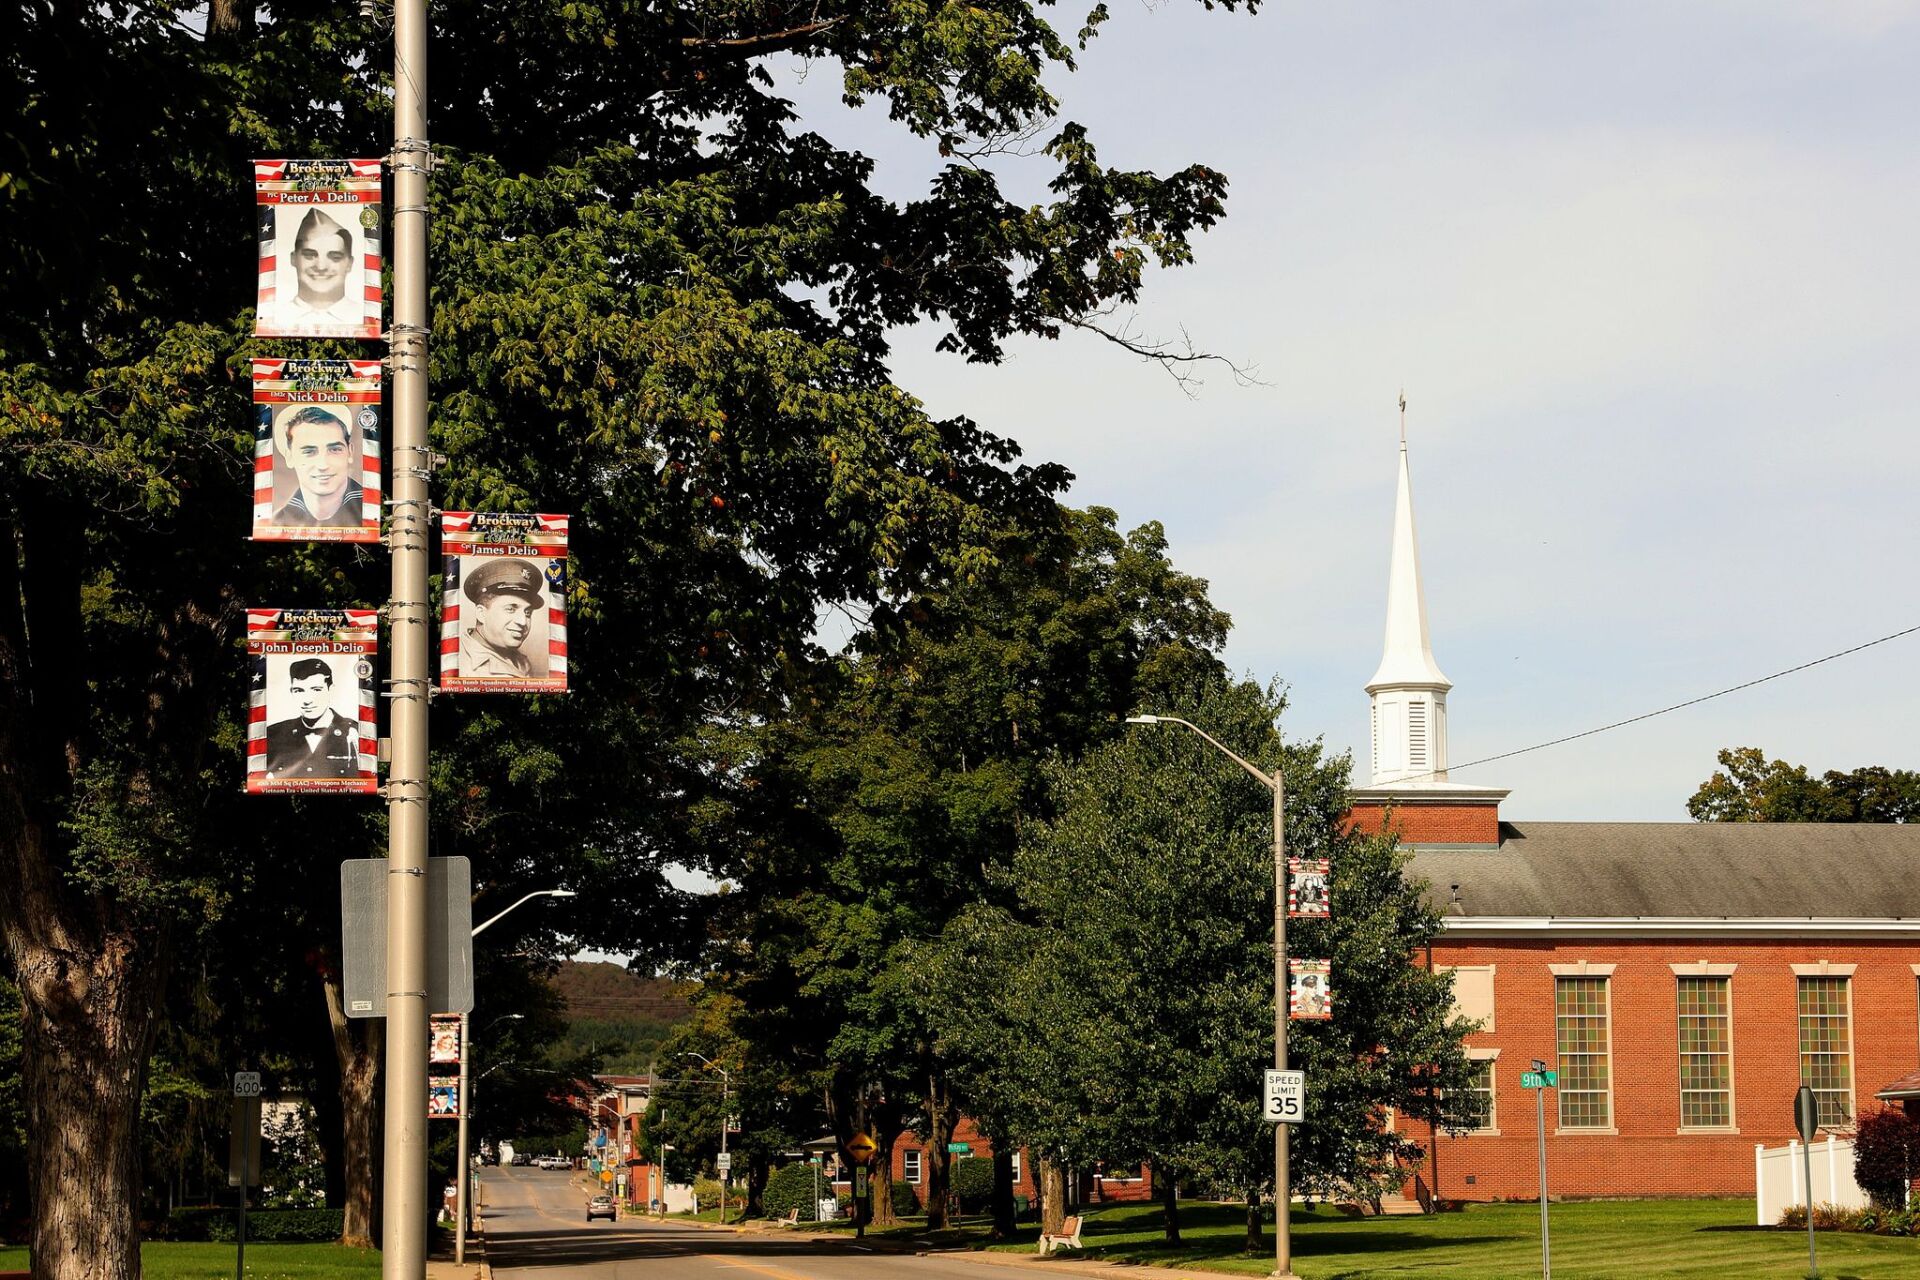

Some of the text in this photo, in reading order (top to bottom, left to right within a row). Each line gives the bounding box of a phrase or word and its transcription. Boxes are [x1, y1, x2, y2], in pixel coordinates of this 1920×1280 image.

[290, 163, 349, 176] Brockway
[280, 193, 309, 202] Peter
[312, 193, 324, 202] A.
[328, 193, 359, 202] Delio
[288, 363, 349, 377] Brockway
[287, 392, 315, 402] Nick
[318, 392, 349, 402] Delio
[477, 515, 536, 529] Brockway
[472, 545, 504, 556] James
[508, 545, 538, 556] Delio
[284, 612, 344, 626] Brockway
[261, 643, 288, 653] John
[291, 643, 330, 654] Joseph
[333, 643, 364, 653] Delio
[1269, 1076, 1300, 1084] SPEED
[1523, 1074, 1541, 1087] 9th
[236, 1082, 258, 1093] 600
[1270, 1097, 1298, 1115] 35
